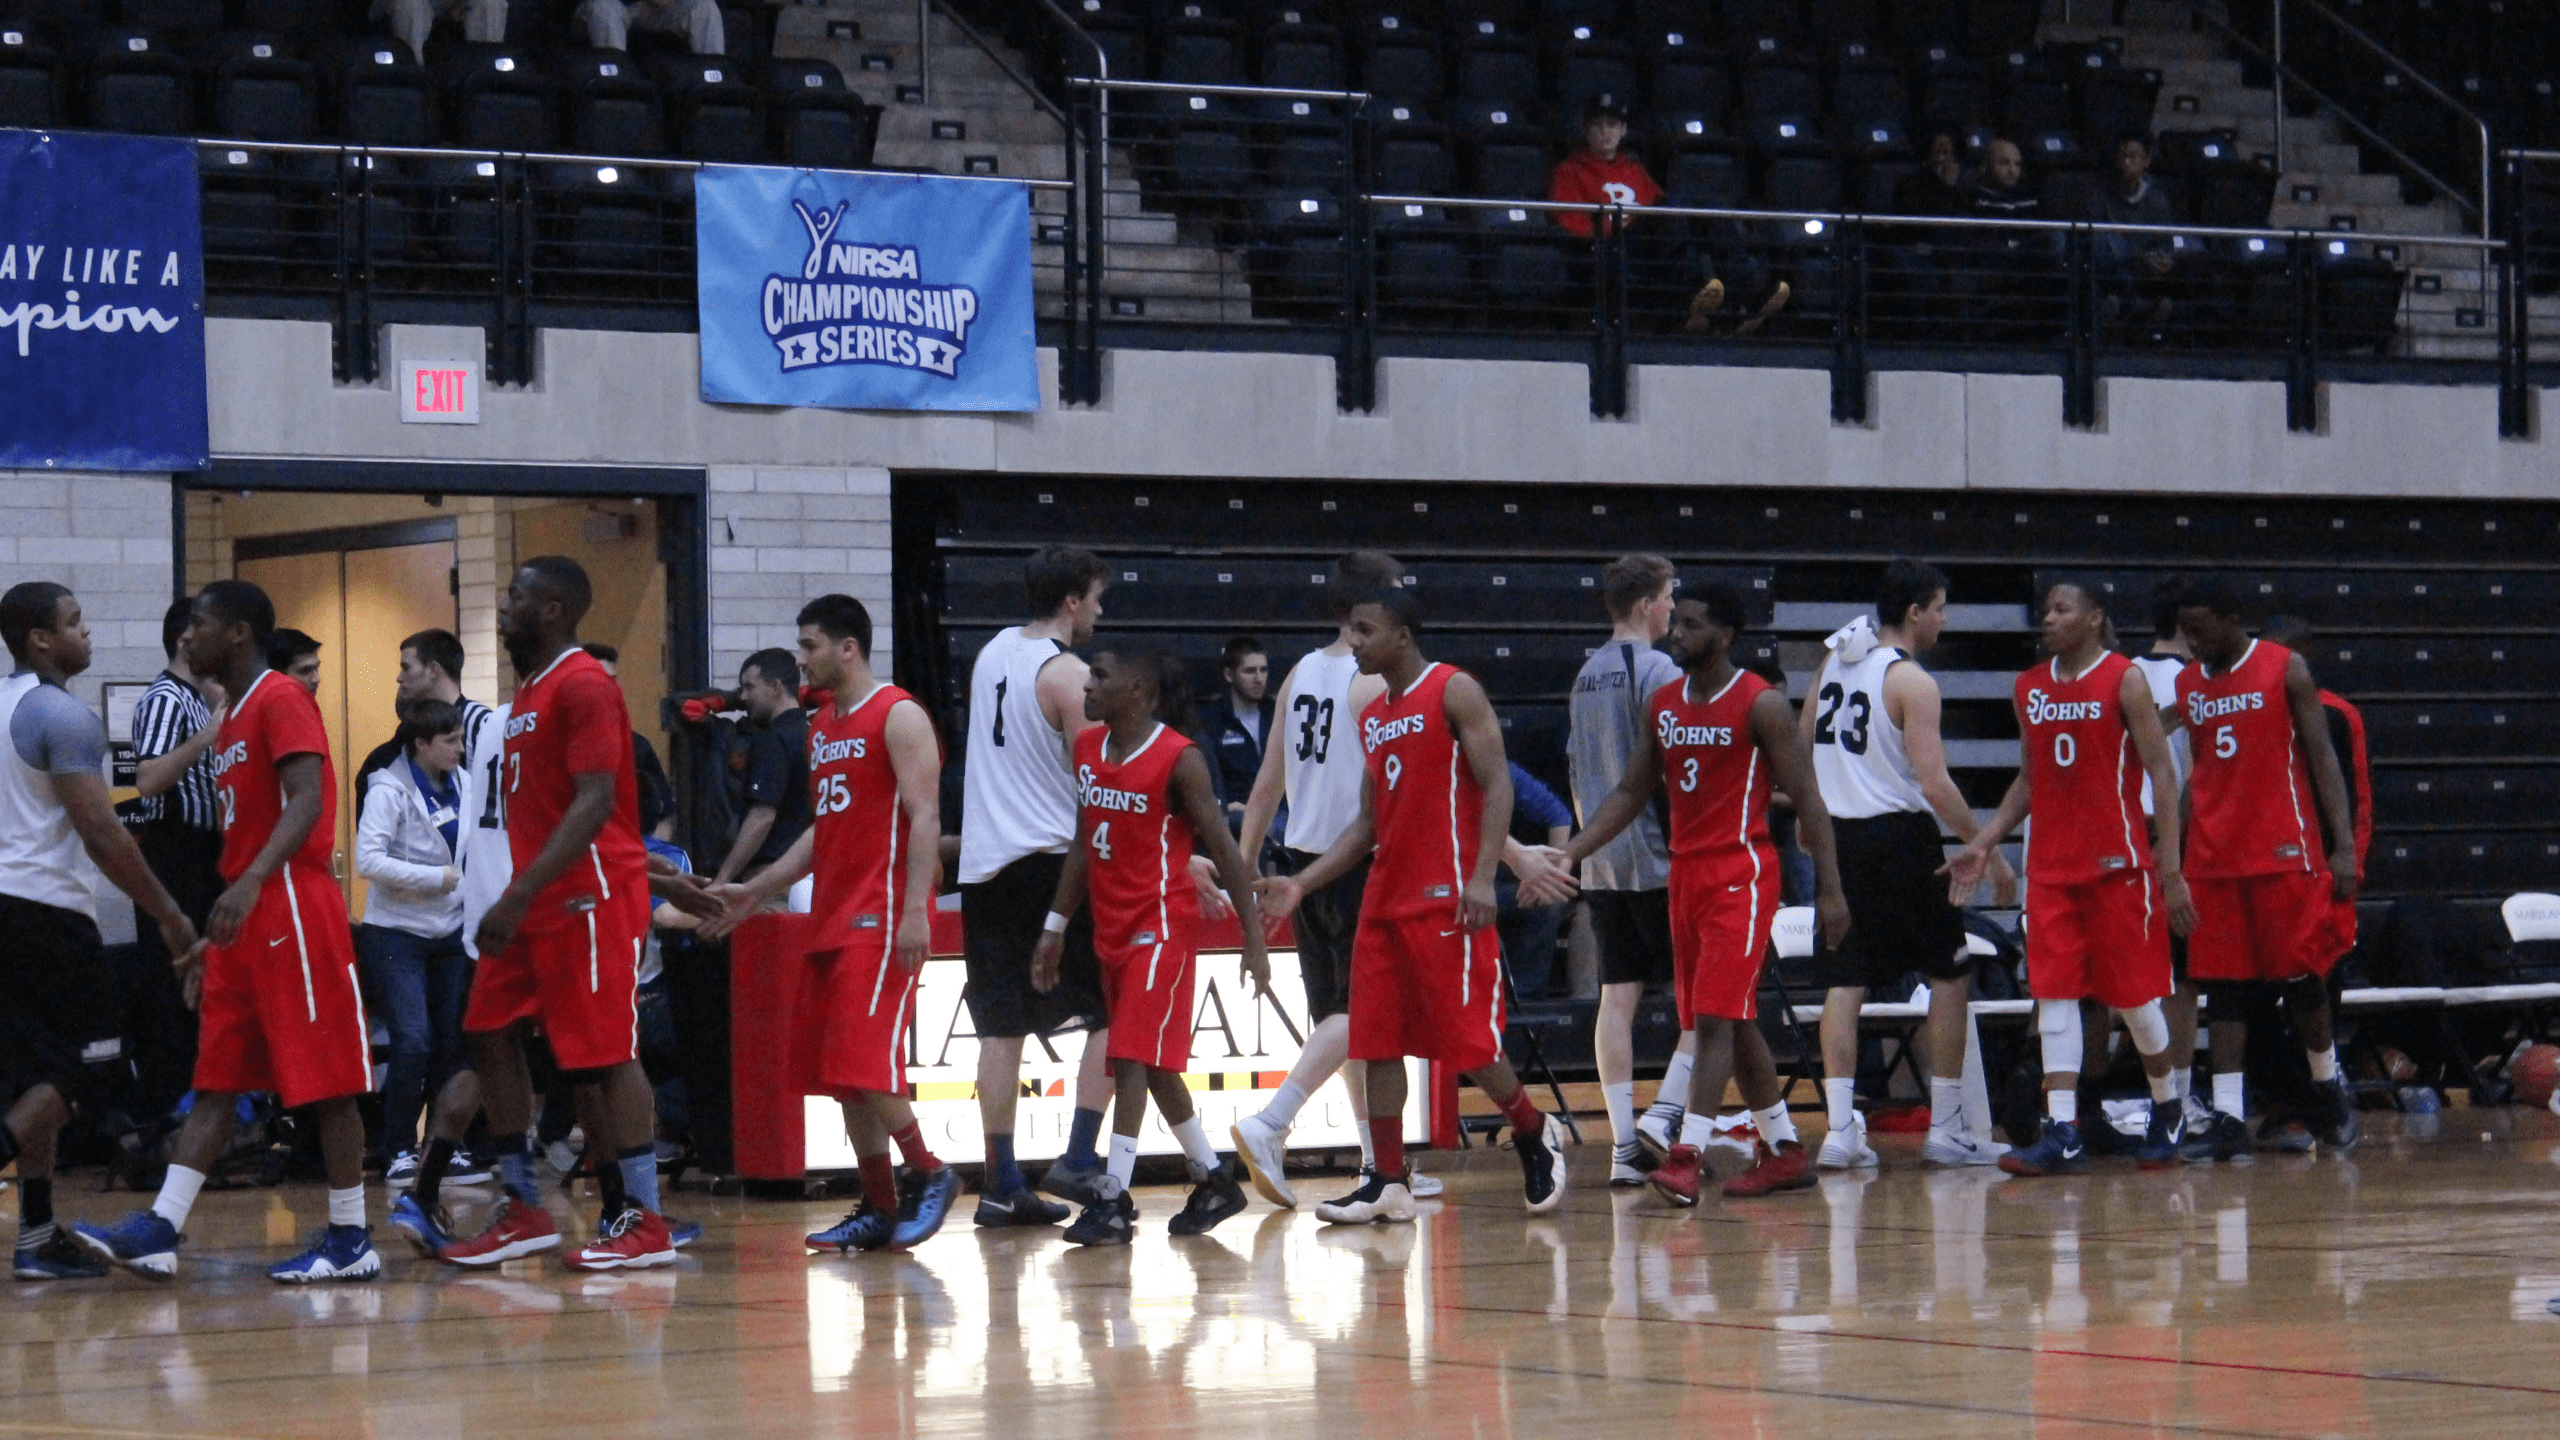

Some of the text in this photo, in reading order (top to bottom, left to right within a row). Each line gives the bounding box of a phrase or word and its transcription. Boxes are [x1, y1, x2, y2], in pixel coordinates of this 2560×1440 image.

[0, 244, 179, 286] AY LIKE A
[826, 244, 918, 279] NIRSA
[764, 278, 976, 341] CHAMPIONSHIP
[819, 325, 917, 366] SERIES
[415, 369, 467, 413] EXIT
[993, 676, 1007, 747] 1
[1294, 694, 1334, 764] 33
[1814, 682, 1871, 756] 23
[2053, 732, 2077, 767] 0
[2215, 725, 2239, 759] 5
[1385, 753, 1403, 791] 9
[1680, 757, 1700, 793] 3
[816, 773, 852, 817] 25
[1091, 821, 1112, 860] 4
[1781, 923, 1816, 937] MARY
